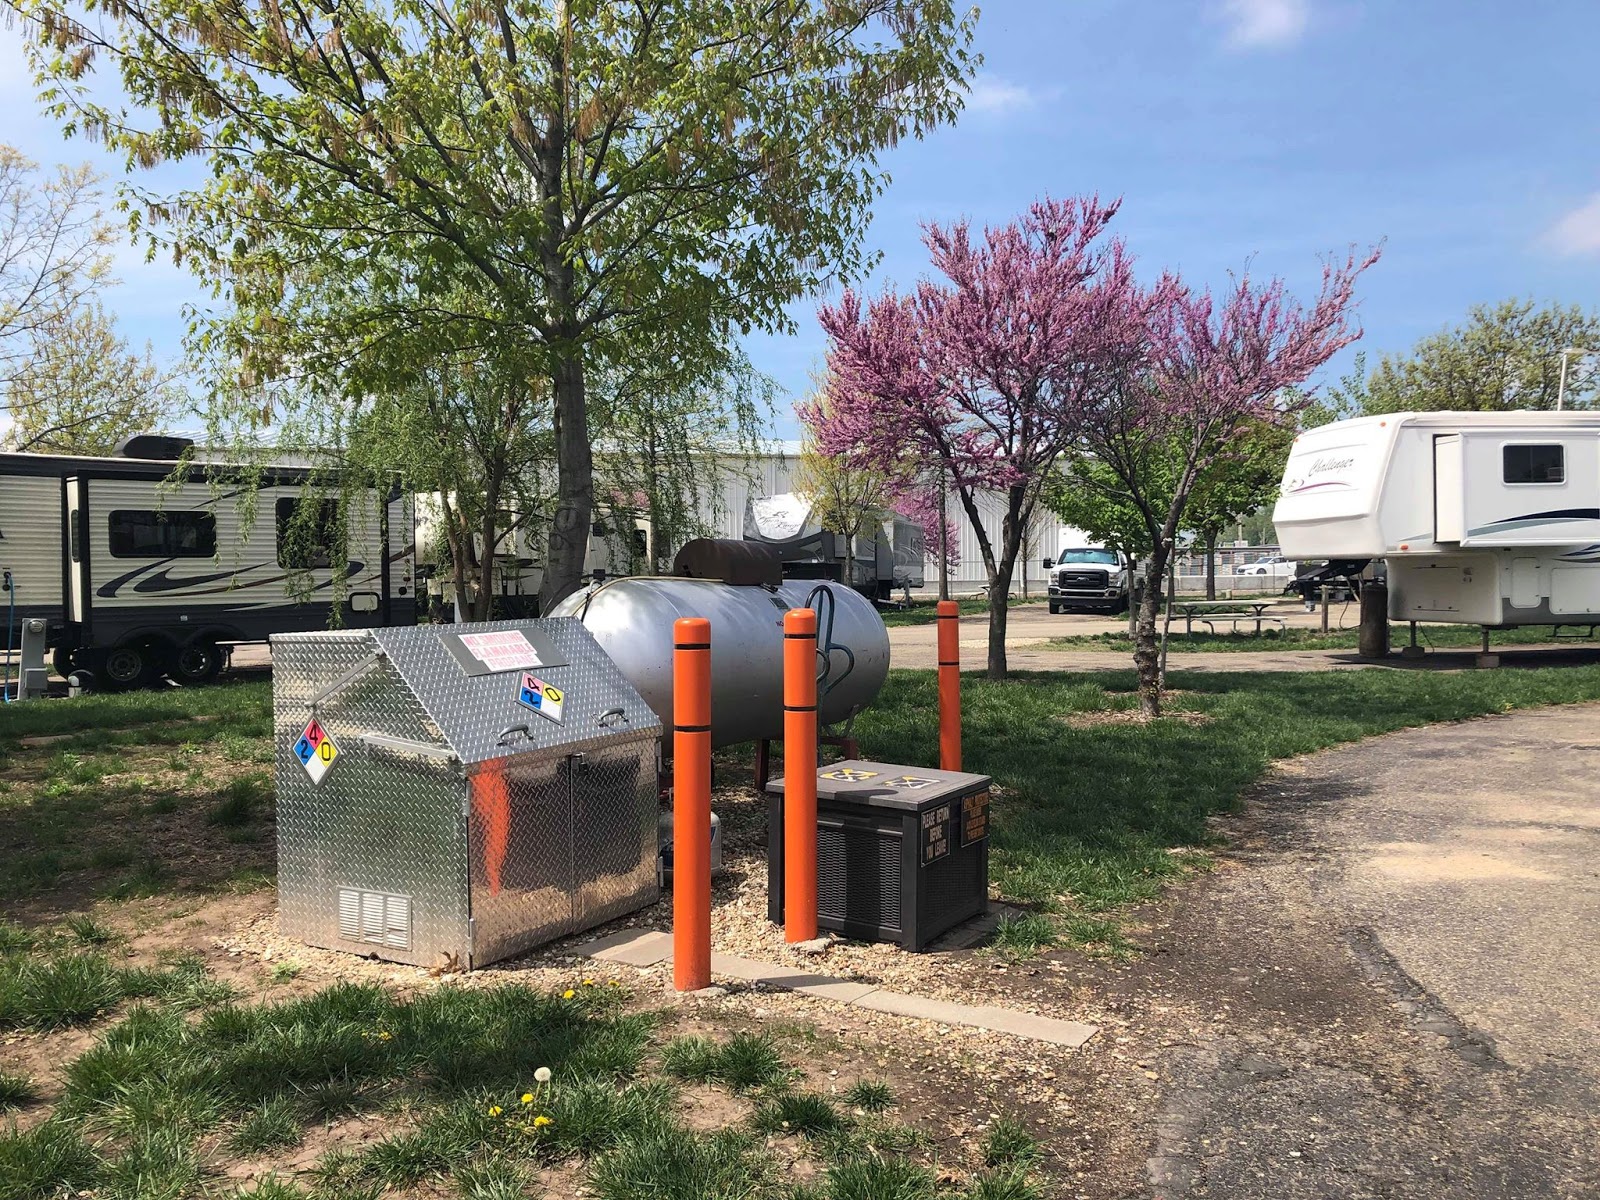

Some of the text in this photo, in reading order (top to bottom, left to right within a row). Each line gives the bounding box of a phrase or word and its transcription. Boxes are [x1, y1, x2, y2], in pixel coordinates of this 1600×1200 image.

[463, 631, 525, 647] NO SMOKING
[471, 642, 537, 659] FLAMMABLE
[487, 654, 539, 669] PROPANE
[527, 677, 541, 692] 4
[523, 690, 540, 705] 2
[544, 687, 561, 702] 0
[309, 724, 319, 745] 4
[300, 739, 331, 762] 2 0
